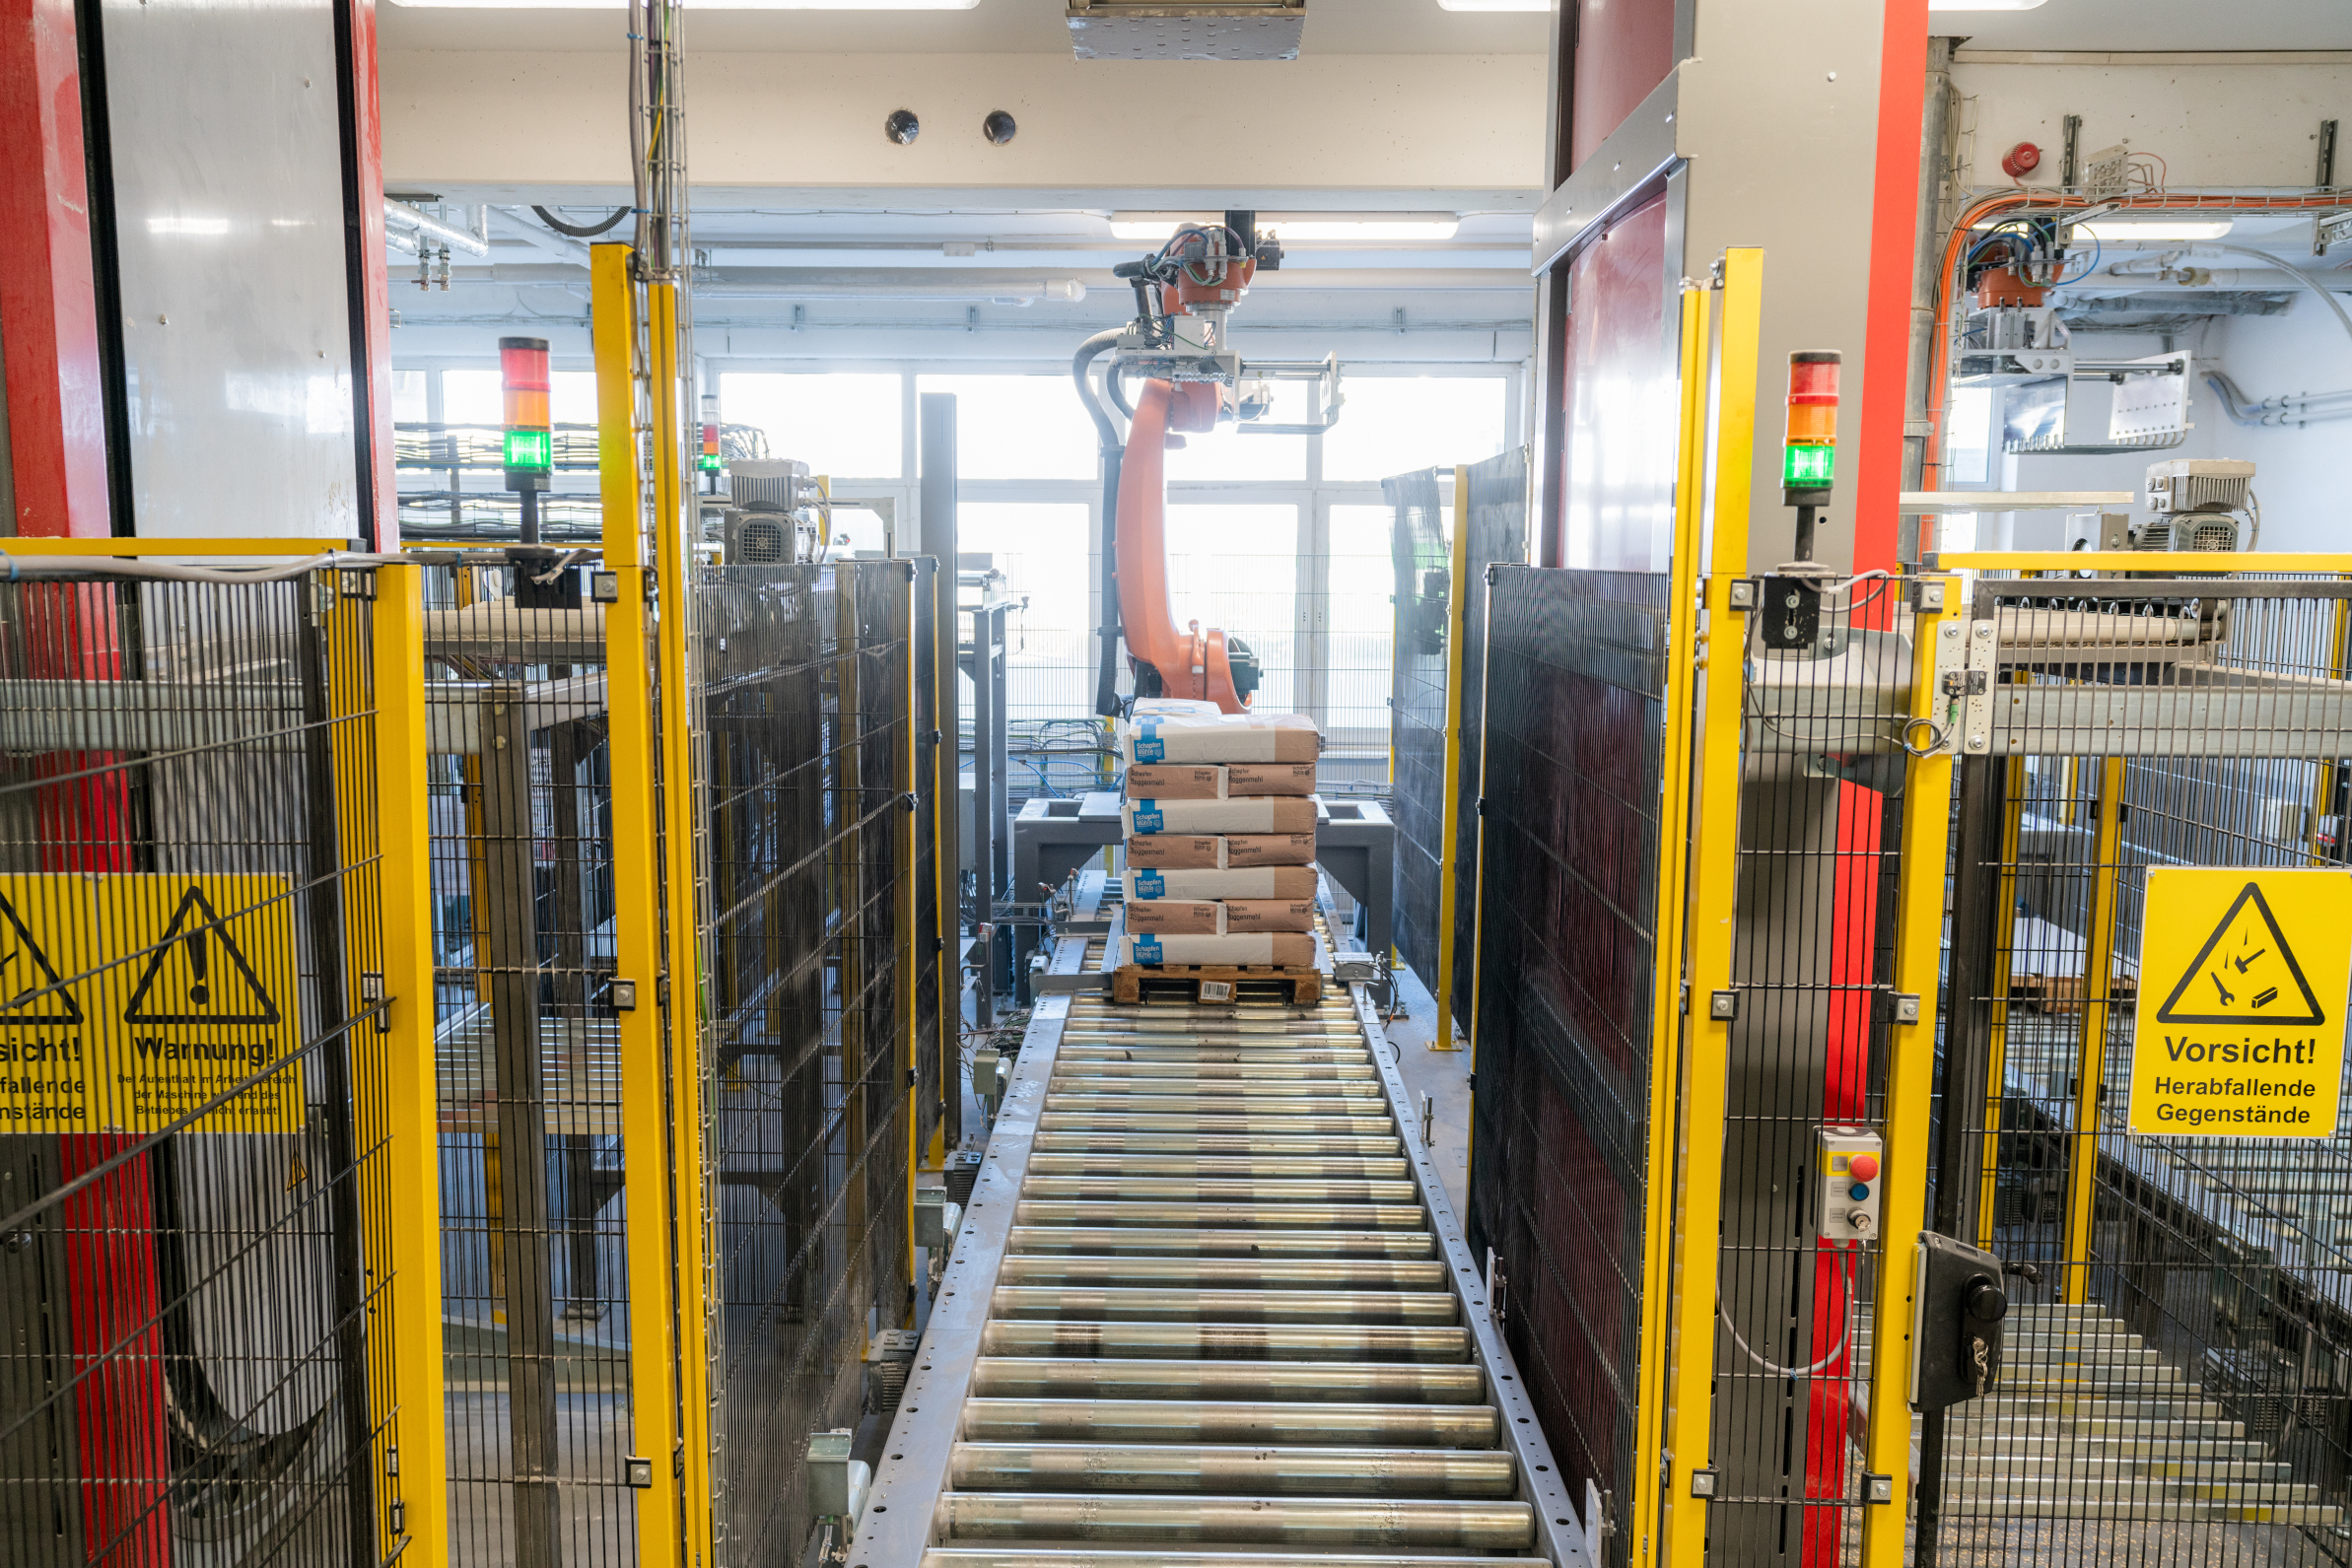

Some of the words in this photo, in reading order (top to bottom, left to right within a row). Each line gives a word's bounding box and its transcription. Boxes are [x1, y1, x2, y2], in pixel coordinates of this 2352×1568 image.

[134, 1037, 274, 1066] Warnung!
[2164, 1036, 2316, 1064] Vorsicht!
[139, 1073, 196, 1084] Auenthat
[216, 1074, 297, 1084] Arbeitereich
[2155, 1076, 2316, 1097] Herabfallende
[134, 1089, 152, 1099] der
[156, 1089, 208, 1100] Maschne
[2156, 1103, 2311, 1126] Gegenstände
